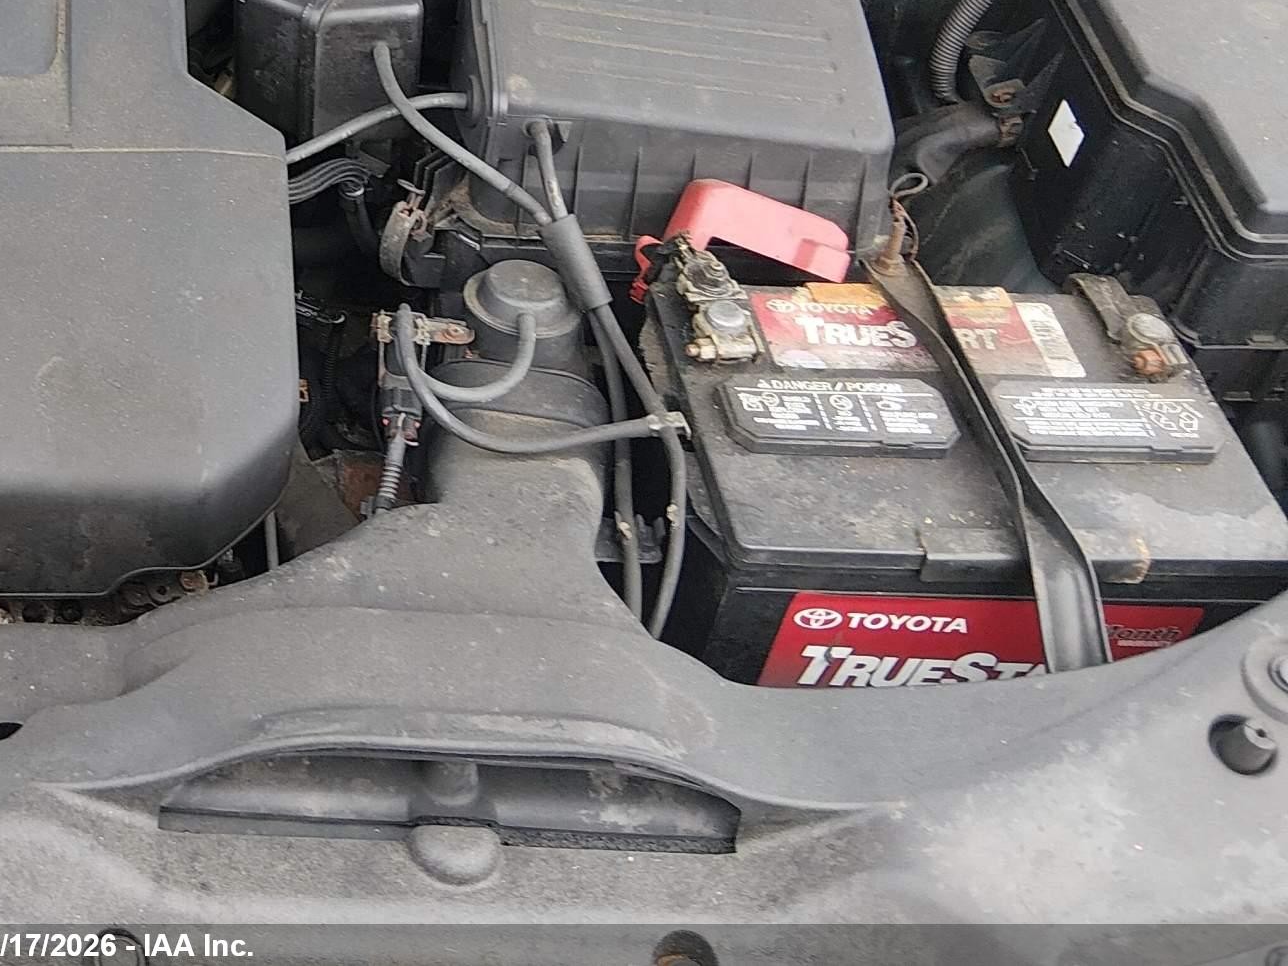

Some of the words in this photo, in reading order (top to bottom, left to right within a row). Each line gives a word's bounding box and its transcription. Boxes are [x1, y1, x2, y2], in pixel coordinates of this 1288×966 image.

[800, 301, 873, 315] TOYOTA
[773, 380, 833, 391] DANGER
[847, 612, 968, 634] TOYOTA
